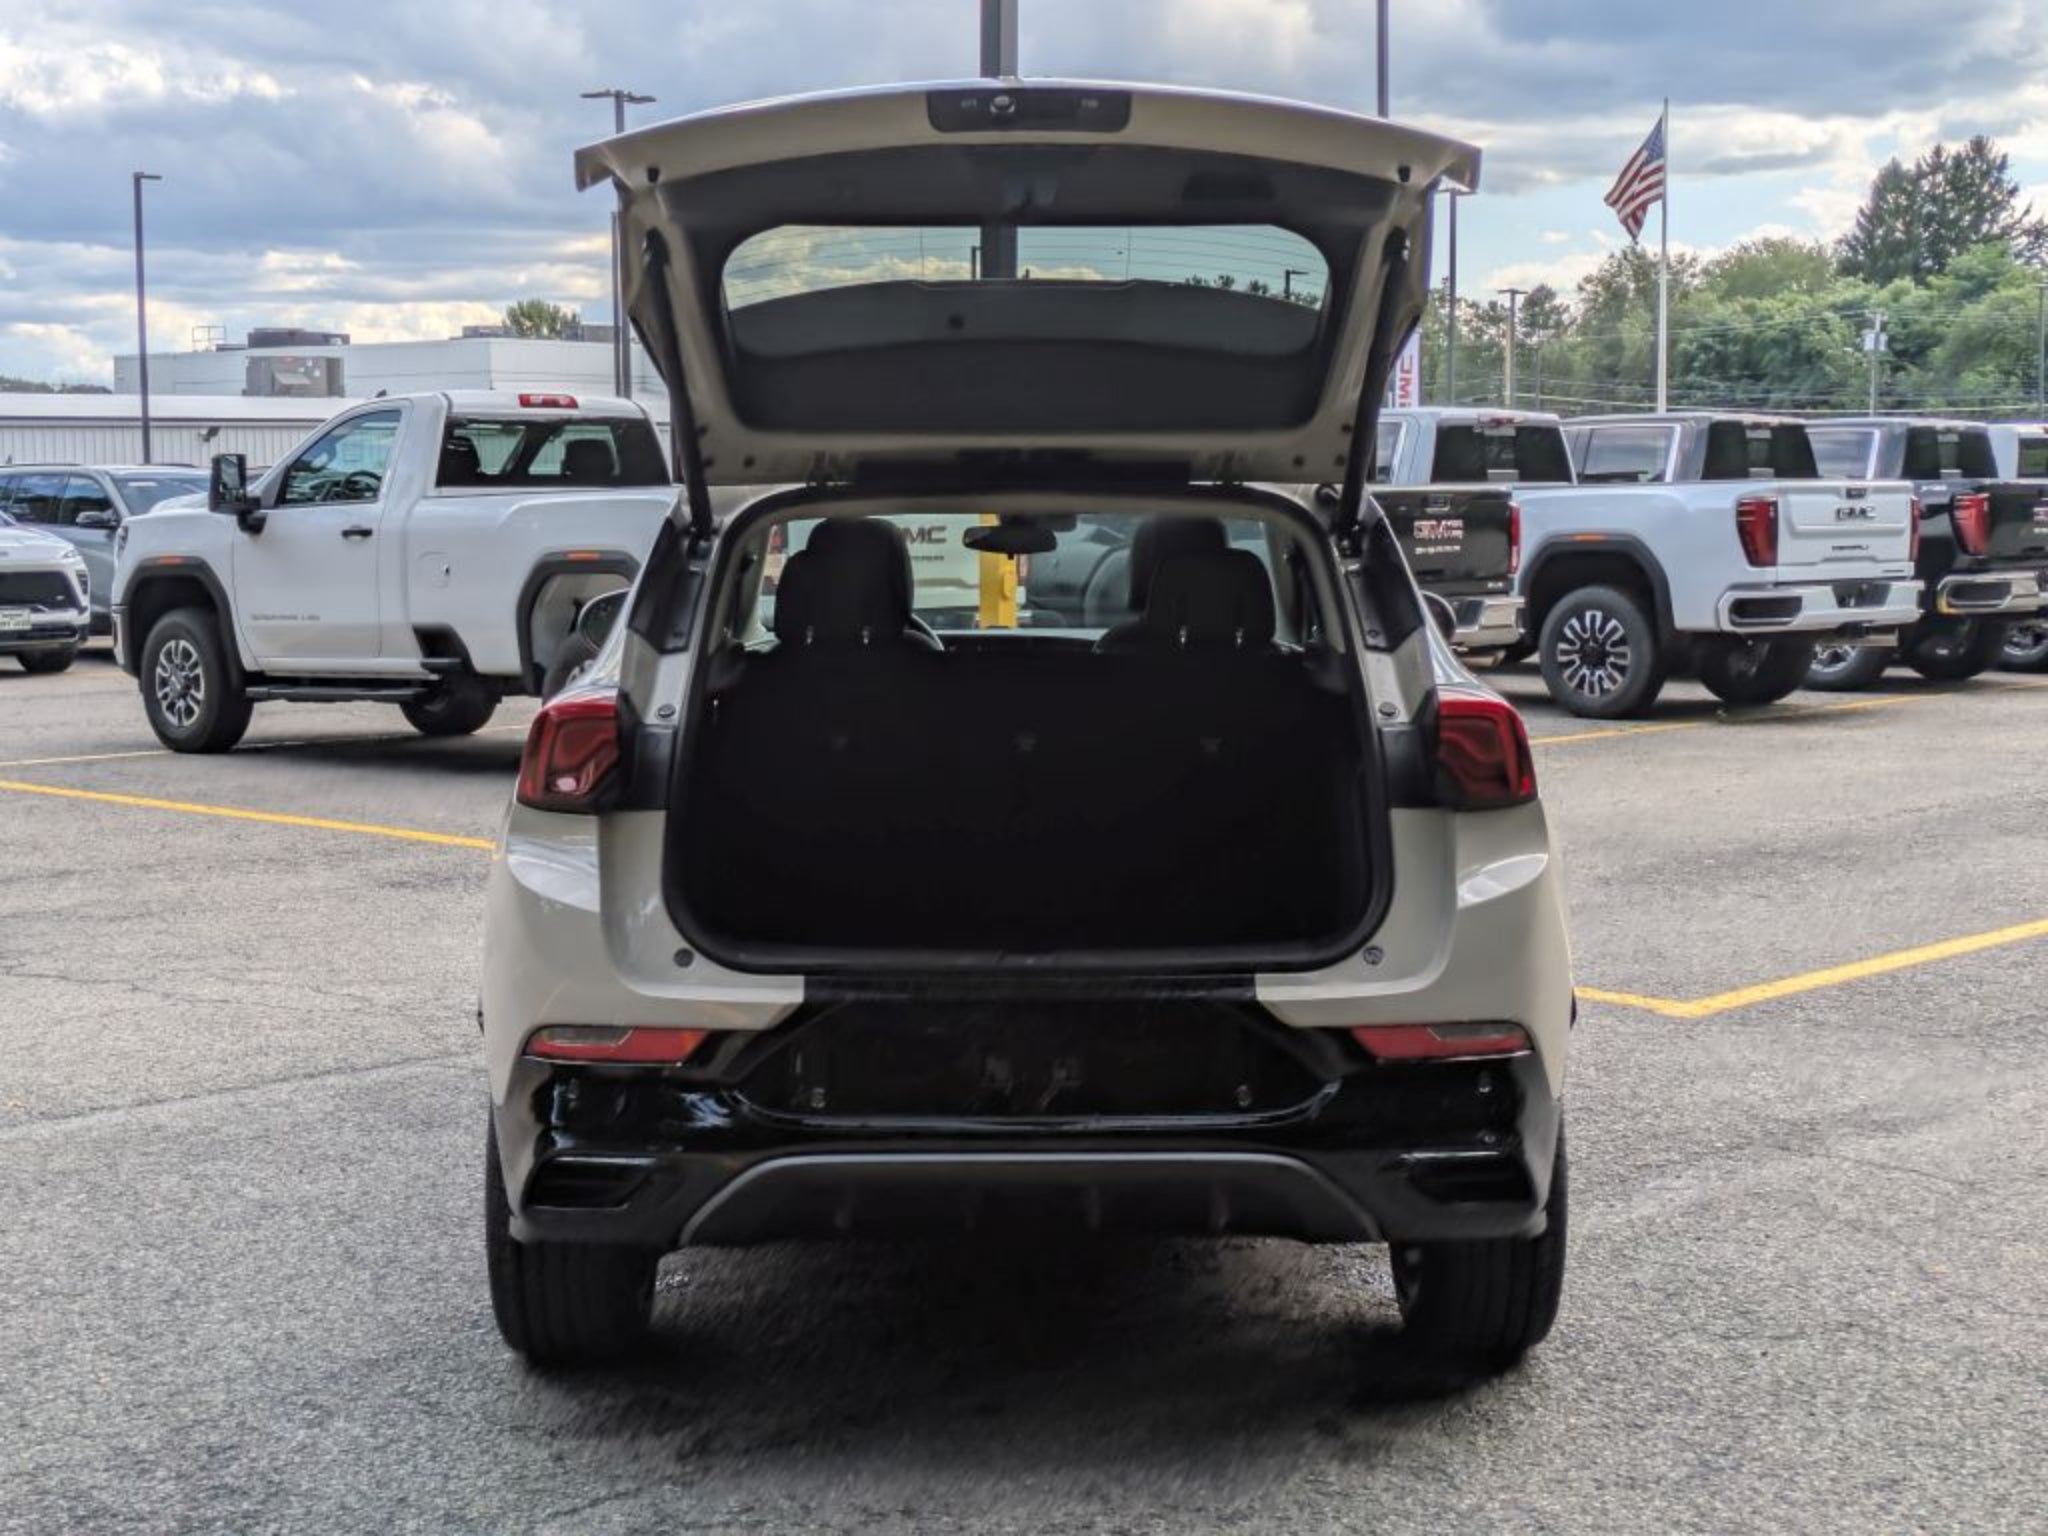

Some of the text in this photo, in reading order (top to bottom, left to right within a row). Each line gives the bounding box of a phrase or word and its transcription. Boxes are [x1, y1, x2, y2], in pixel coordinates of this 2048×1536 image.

[1399, 353, 1412, 407] MC
[1836, 506, 1876, 521] GMC
[898, 525, 947, 544] MC
